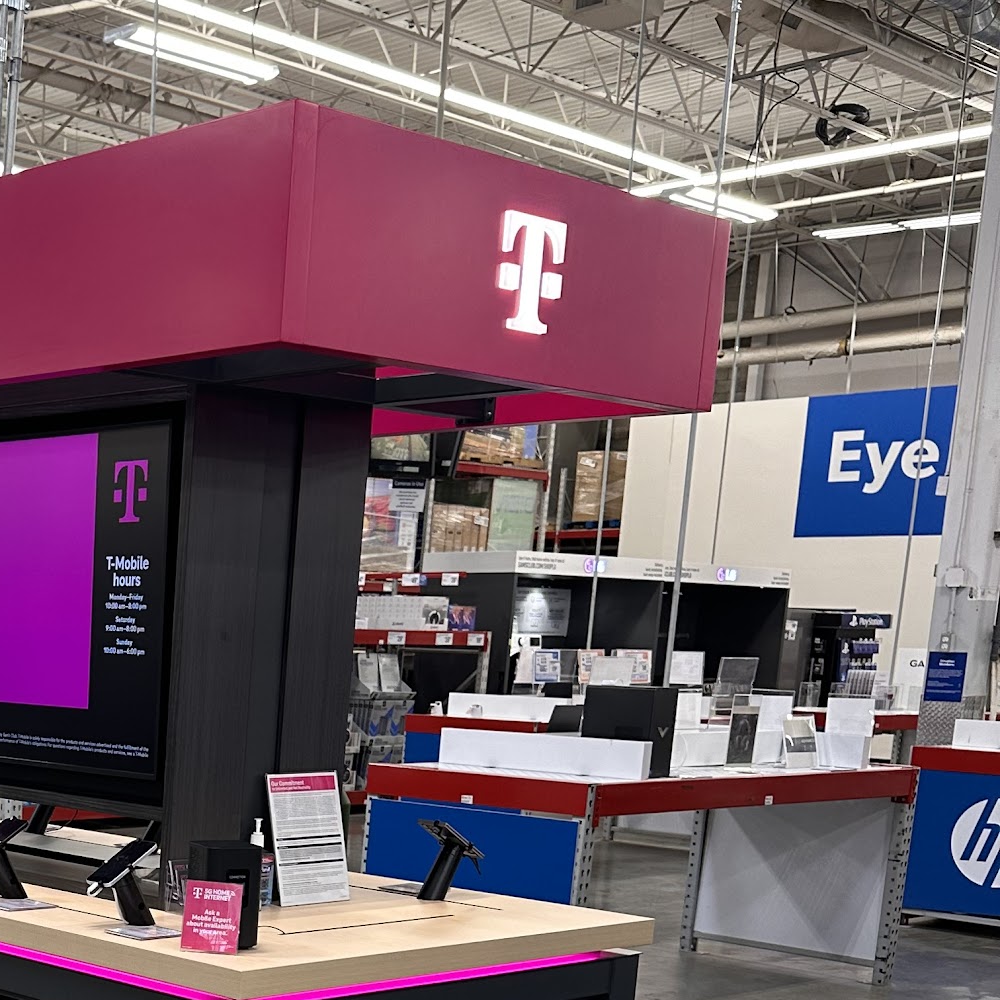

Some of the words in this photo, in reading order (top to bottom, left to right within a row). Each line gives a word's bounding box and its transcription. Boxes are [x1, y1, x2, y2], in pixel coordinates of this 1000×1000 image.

[827, 429, 940, 494] Eye
[105, 555, 150, 571] T-Mobile
[112, 572, 142, 587] hours
[116, 638, 133, 647] Sunday
[213, 888, 230, 896] HOME
[192, 914, 211, 922] Mobile
[204, 922, 236, 931] availability
